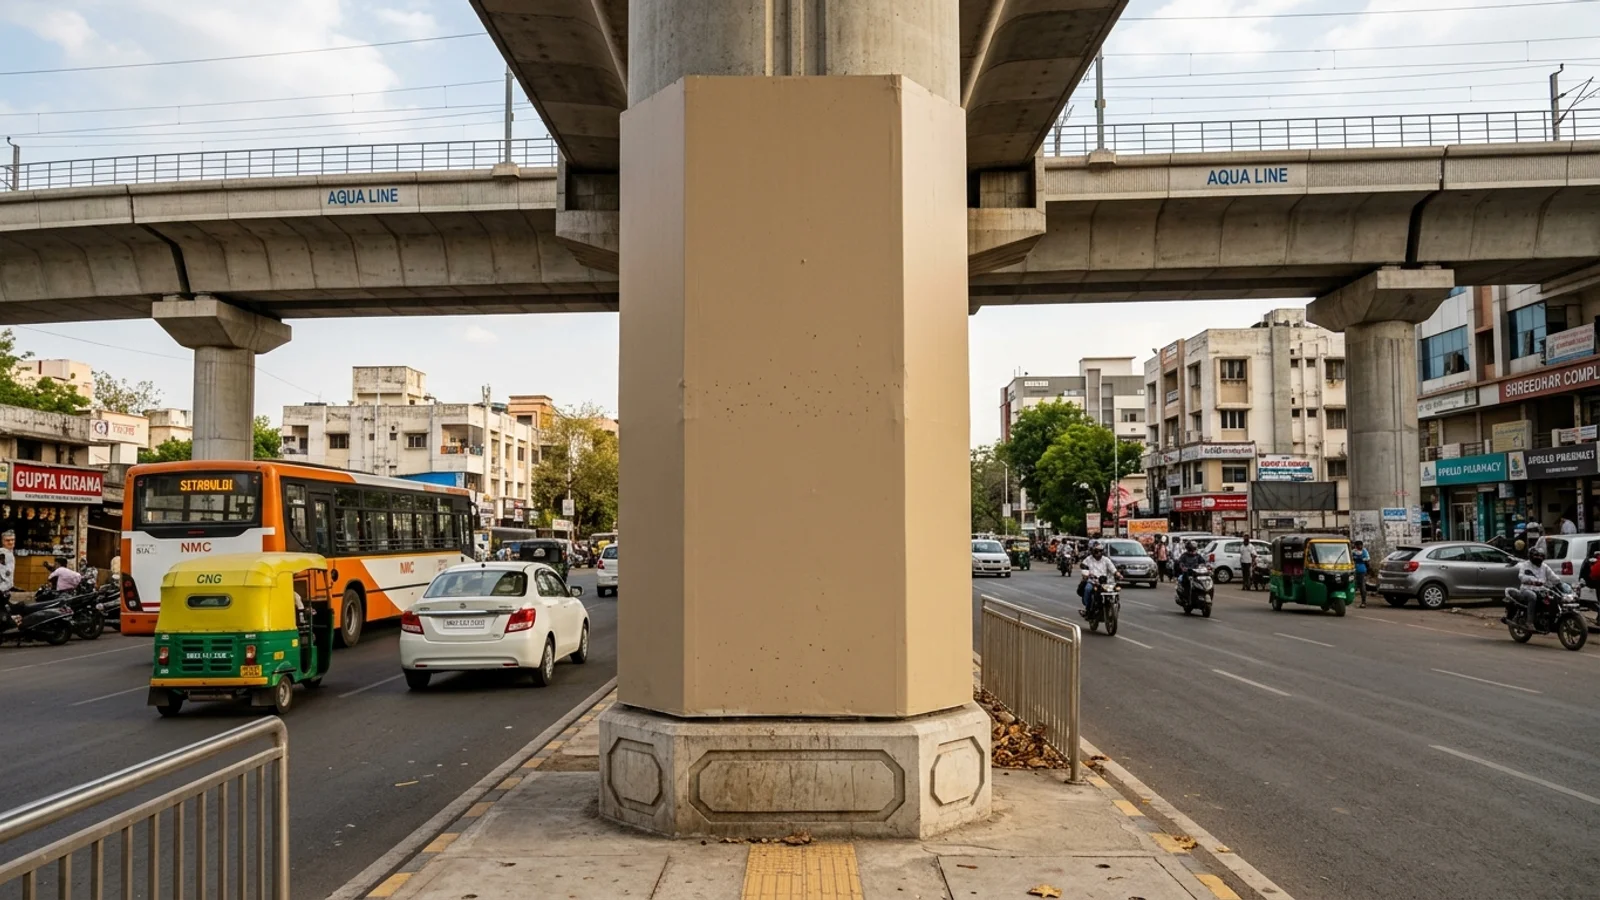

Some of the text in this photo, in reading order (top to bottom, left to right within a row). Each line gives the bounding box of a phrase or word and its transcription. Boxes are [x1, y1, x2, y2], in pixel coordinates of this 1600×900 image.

[1207, 167, 1288, 185] AQUA LINE
[328, 188, 398, 206] AQUA LINE
[16, 470, 102, 492] GUPTA KIRANA
[181, 541, 212, 553] NMC
[197, 573, 223, 584] CNG
